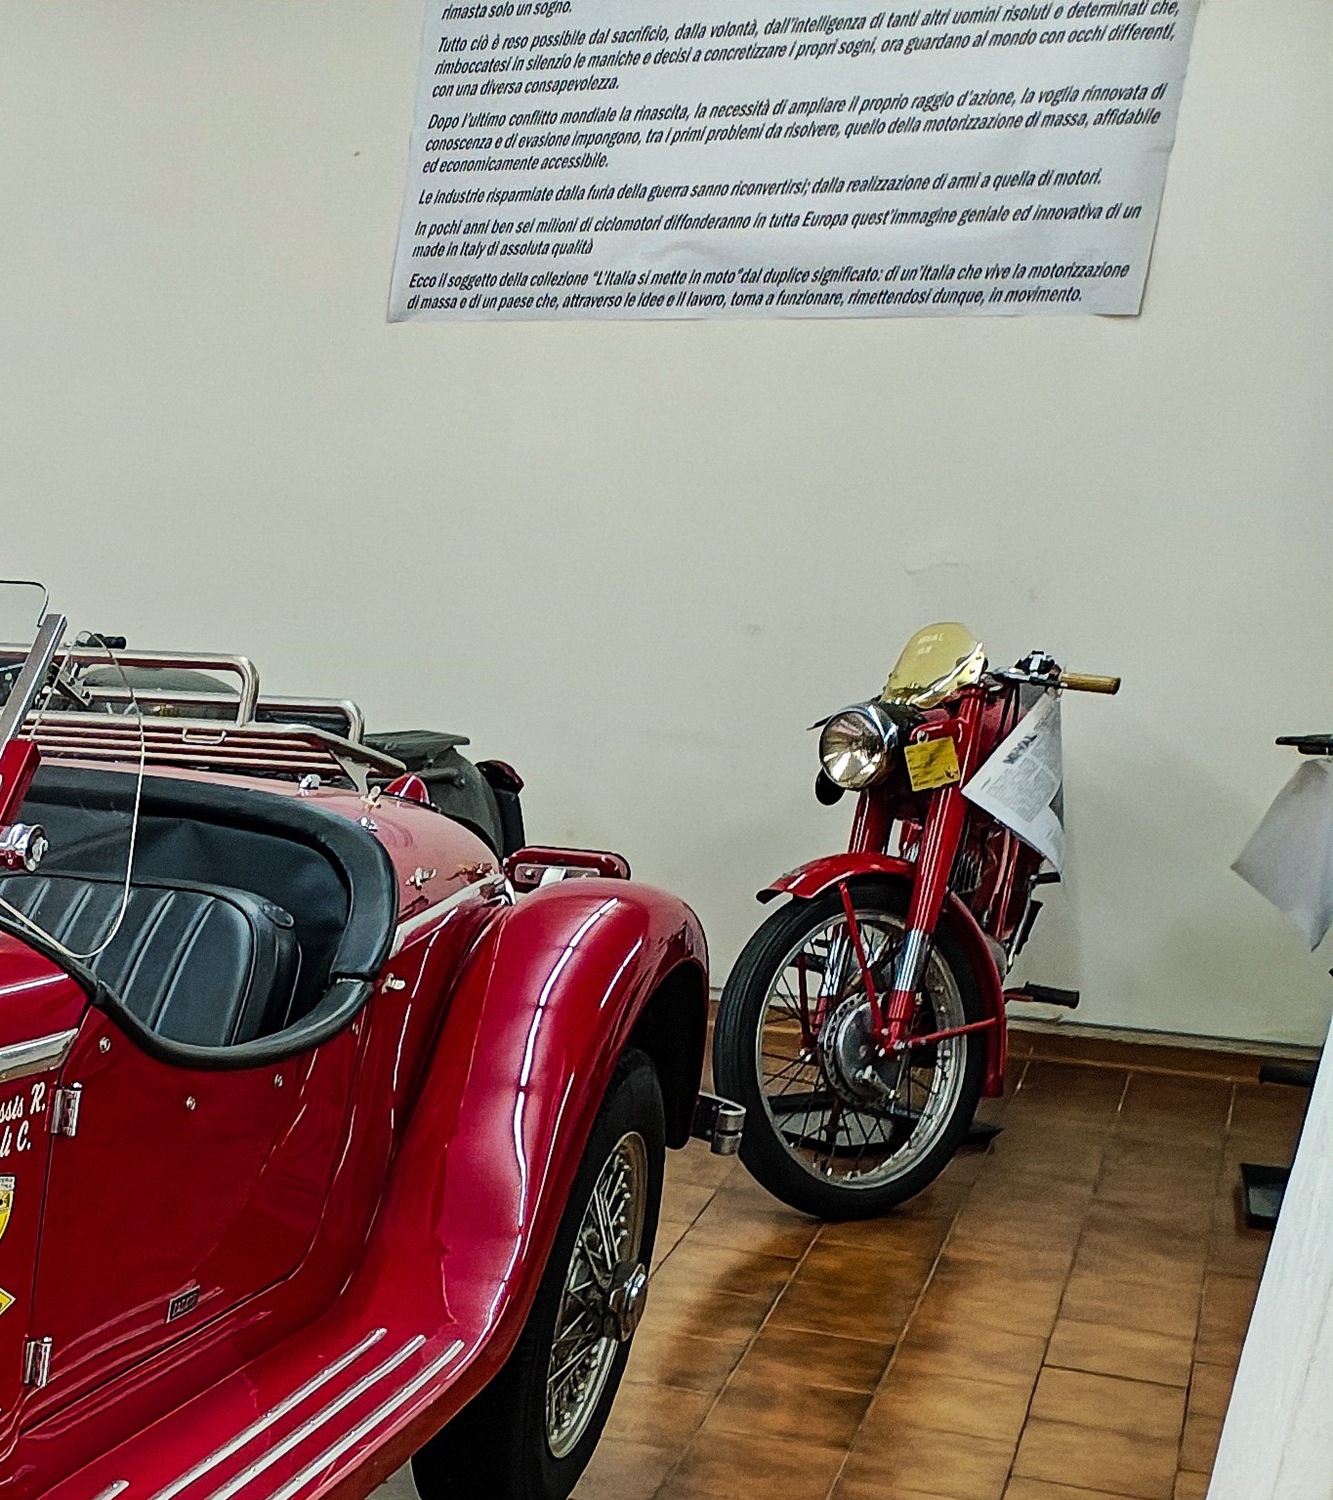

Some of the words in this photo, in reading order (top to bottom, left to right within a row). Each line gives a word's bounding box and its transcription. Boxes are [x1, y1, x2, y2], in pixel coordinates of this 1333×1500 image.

[438, 36, 467, 52] Tutto
[470, 33, 488, 51] ciò
[501, 35, 529, 50] reso
[529, 28, 586, 52] possibile
[588, 27, 611, 45] dal
[611, 24, 669, 43] sacrificio,
[674, 22, 706, 40] dalla
[710, 18, 758, 38] volontà,
[869, 11, 886, 29] di
[886, 8, 921, 28] tanti
[920, 7, 951, 26] altri
[952, 5, 1003, 24] uomini
[1002, 2, 1053, 21] risoluti
[1066, 0, 1149, 19] determinati
[1150, 0, 1179, 17] che,
[441, 2, 487, 20] rimasta
[488, 0, 514, 18] solo
[515, 2, 532, 16] un
[532, 0, 572, 18] sogno.
[434, 55, 513, 75] rimboccatesi
[525, 52, 572, 71] silenzio
[587, 49, 641, 68] maniche
[653, 46, 693, 64] decisi
[703, 41, 787, 62] concretizzare
[794, 38, 838, 60] propri
[837, 35, 877, 57] sogni,
[880, 38, 904, 52] ora
[903, 32, 971, 55] guardano
[988, 28, 1037, 46] mondo
[1039, 29, 1066, 44] con
[1067, 24, 1108, 43] occhi
[1107, 21, 1176, 41] differenti,
[432, 84, 454, 98] con
[455, 82, 478, 96] una
[479, 78, 523, 95] diversa
[524, 73, 619, 95] consapevolezza.
[427, 113, 459, 132] Dopo
[508, 108, 558, 126] conflitto
[559, 106, 617, 125] mondiale
[618, 105, 632, 121] la
[633, 103, 690, 122] rinascita,
[693, 102, 707, 119] la
[708, 97, 770, 118] necessità
[772, 98, 789, 115] di
[787, 96, 846, 117] ampliare
[858, 92, 909, 115] proprio
[910, 90, 954, 112] raggio
[1020, 87, 1035, 104] la
[1038, 85, 1079, 106] voglia
[1081, 84, 1148, 101] rinnovata
[1150, 82, 1168, 100] di
[425, 136, 493, 152] conoscenza
[518, 131, 571, 148] evasione
[571, 129, 641, 149] impongono,
[645, 128, 663, 143] tra
[669, 125, 707, 146] primi
[704, 122, 766, 144] problemi
[783, 120, 840, 138] risolvere,
[844, 117, 886, 139] quello
[887, 116, 921, 134] della
[922, 112, 1023, 132] motorizzazione
[1040, 112, 1088, 128] massa,
[1092, 106, 1161, 125] affidabile
[439, 155, 539, 173] economicamente
[540, 151, 608, 170] accessibile.
[418, 188, 433, 204] Le
[433, 187, 485, 204] industrie
[485, 185, 554, 206] risparmiate
[555, 184, 585, 201] dalla
[586, 183, 615, 200] furia
[616, 182, 647, 199] della
[646, 184, 689, 202] guerra
[689, 183, 729, 197] sanno
[729, 177, 811, 196] riconvertirsi;
[811, 176, 845, 194] dalla
[845, 174, 930, 192] realizzazione
[947, 171, 982, 189] armi
[992, 170, 1036, 191] quella
[1053, 167, 1102, 186] motori.
[426, 218, 463, 239] pochi
[462, 218, 491, 235] anni
[490, 218, 514, 234] ben
[515, 217, 536, 234] sei
[535, 216, 579, 233] milioni
[594, 214, 664, 232] ciclomotori
[663, 212, 751, 230] diffonderanno
[768, 212, 800, 228] tutta
[801, 210, 849, 230] Europa
[957, 204, 1010, 226] geniale
[1012, 204, 1033, 221] ed
[1032, 202, 1103, 221] innovativa
[1122, 205, 1142, 219] un
[411, 240, 445, 257] made
[459, 240, 487, 260] Italy
[499, 239, 550, 256] assoluta
[551, 237, 593, 258] qualità
[408, 272, 439, 288] Ecco
[447, 272, 497, 291] soggetto
[498, 271, 528, 287] della
[529, 270, 589, 286] collezione
[648, 269, 687, 285] mette
[762, 266, 810, 287] duplice
[810, 265, 884, 286] significato:
[957, 263, 982, 280] che
[984, 262, 1011, 279] vive
[1027, 260, 1130, 279] motorizzazione
[419, 295, 457, 309] massa
[496, 295, 534, 311] paese
[535, 292, 559, 310] che,
[562, 292, 625, 308] attraverso
[636, 288, 665, 307] idee
[686, 290, 726, 309] lavoro,
[775, 288, 844, 307] funzionare,
[847, 287, 933, 305] rimettendosi
[932, 286, 984, 306] dunque,
[1003, 285, 1082, 302] movimento.
[30, 1081, 46, 1115] R.
[17, 1120, 31, 1152] C.
